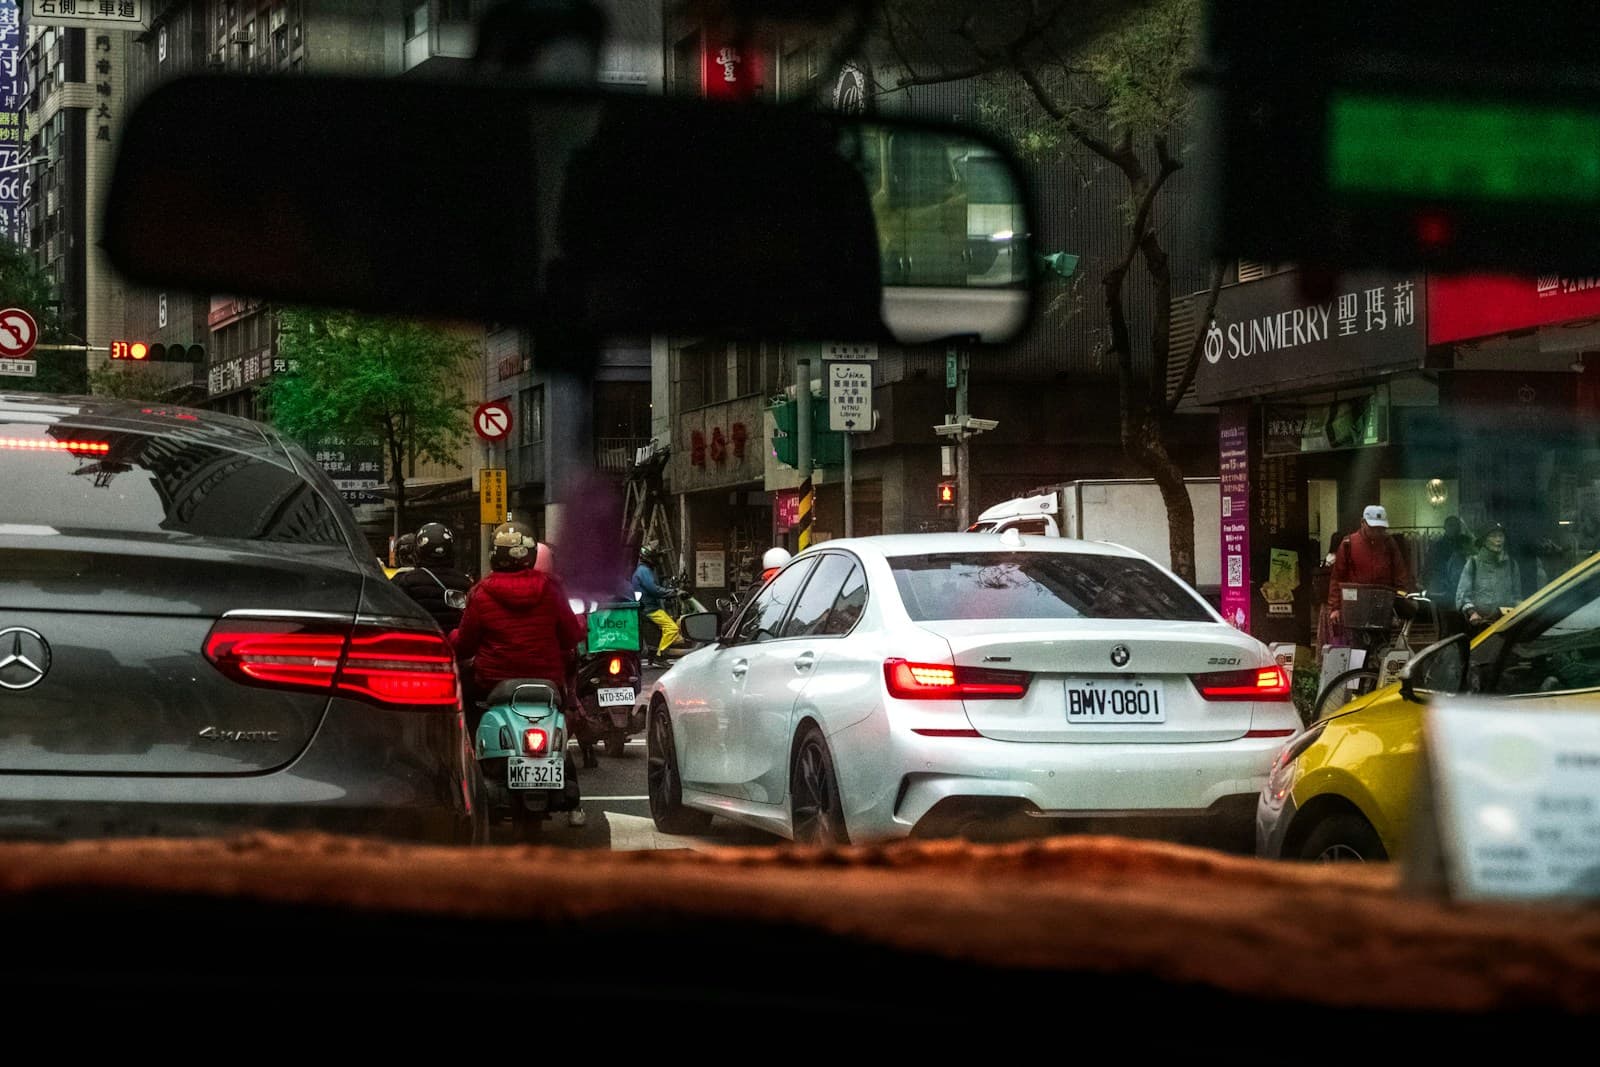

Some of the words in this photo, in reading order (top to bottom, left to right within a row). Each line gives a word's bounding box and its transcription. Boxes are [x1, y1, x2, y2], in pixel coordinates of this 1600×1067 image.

[39, 0, 136, 19] 右側二車道
[1228, 301, 1334, 360] SUNMERRY
[1337, 279, 1415, 338] 聖瑪莉
[1068, 688, 1160, 716] BMV-0801
[510, 766, 562, 783] MKF-3213
